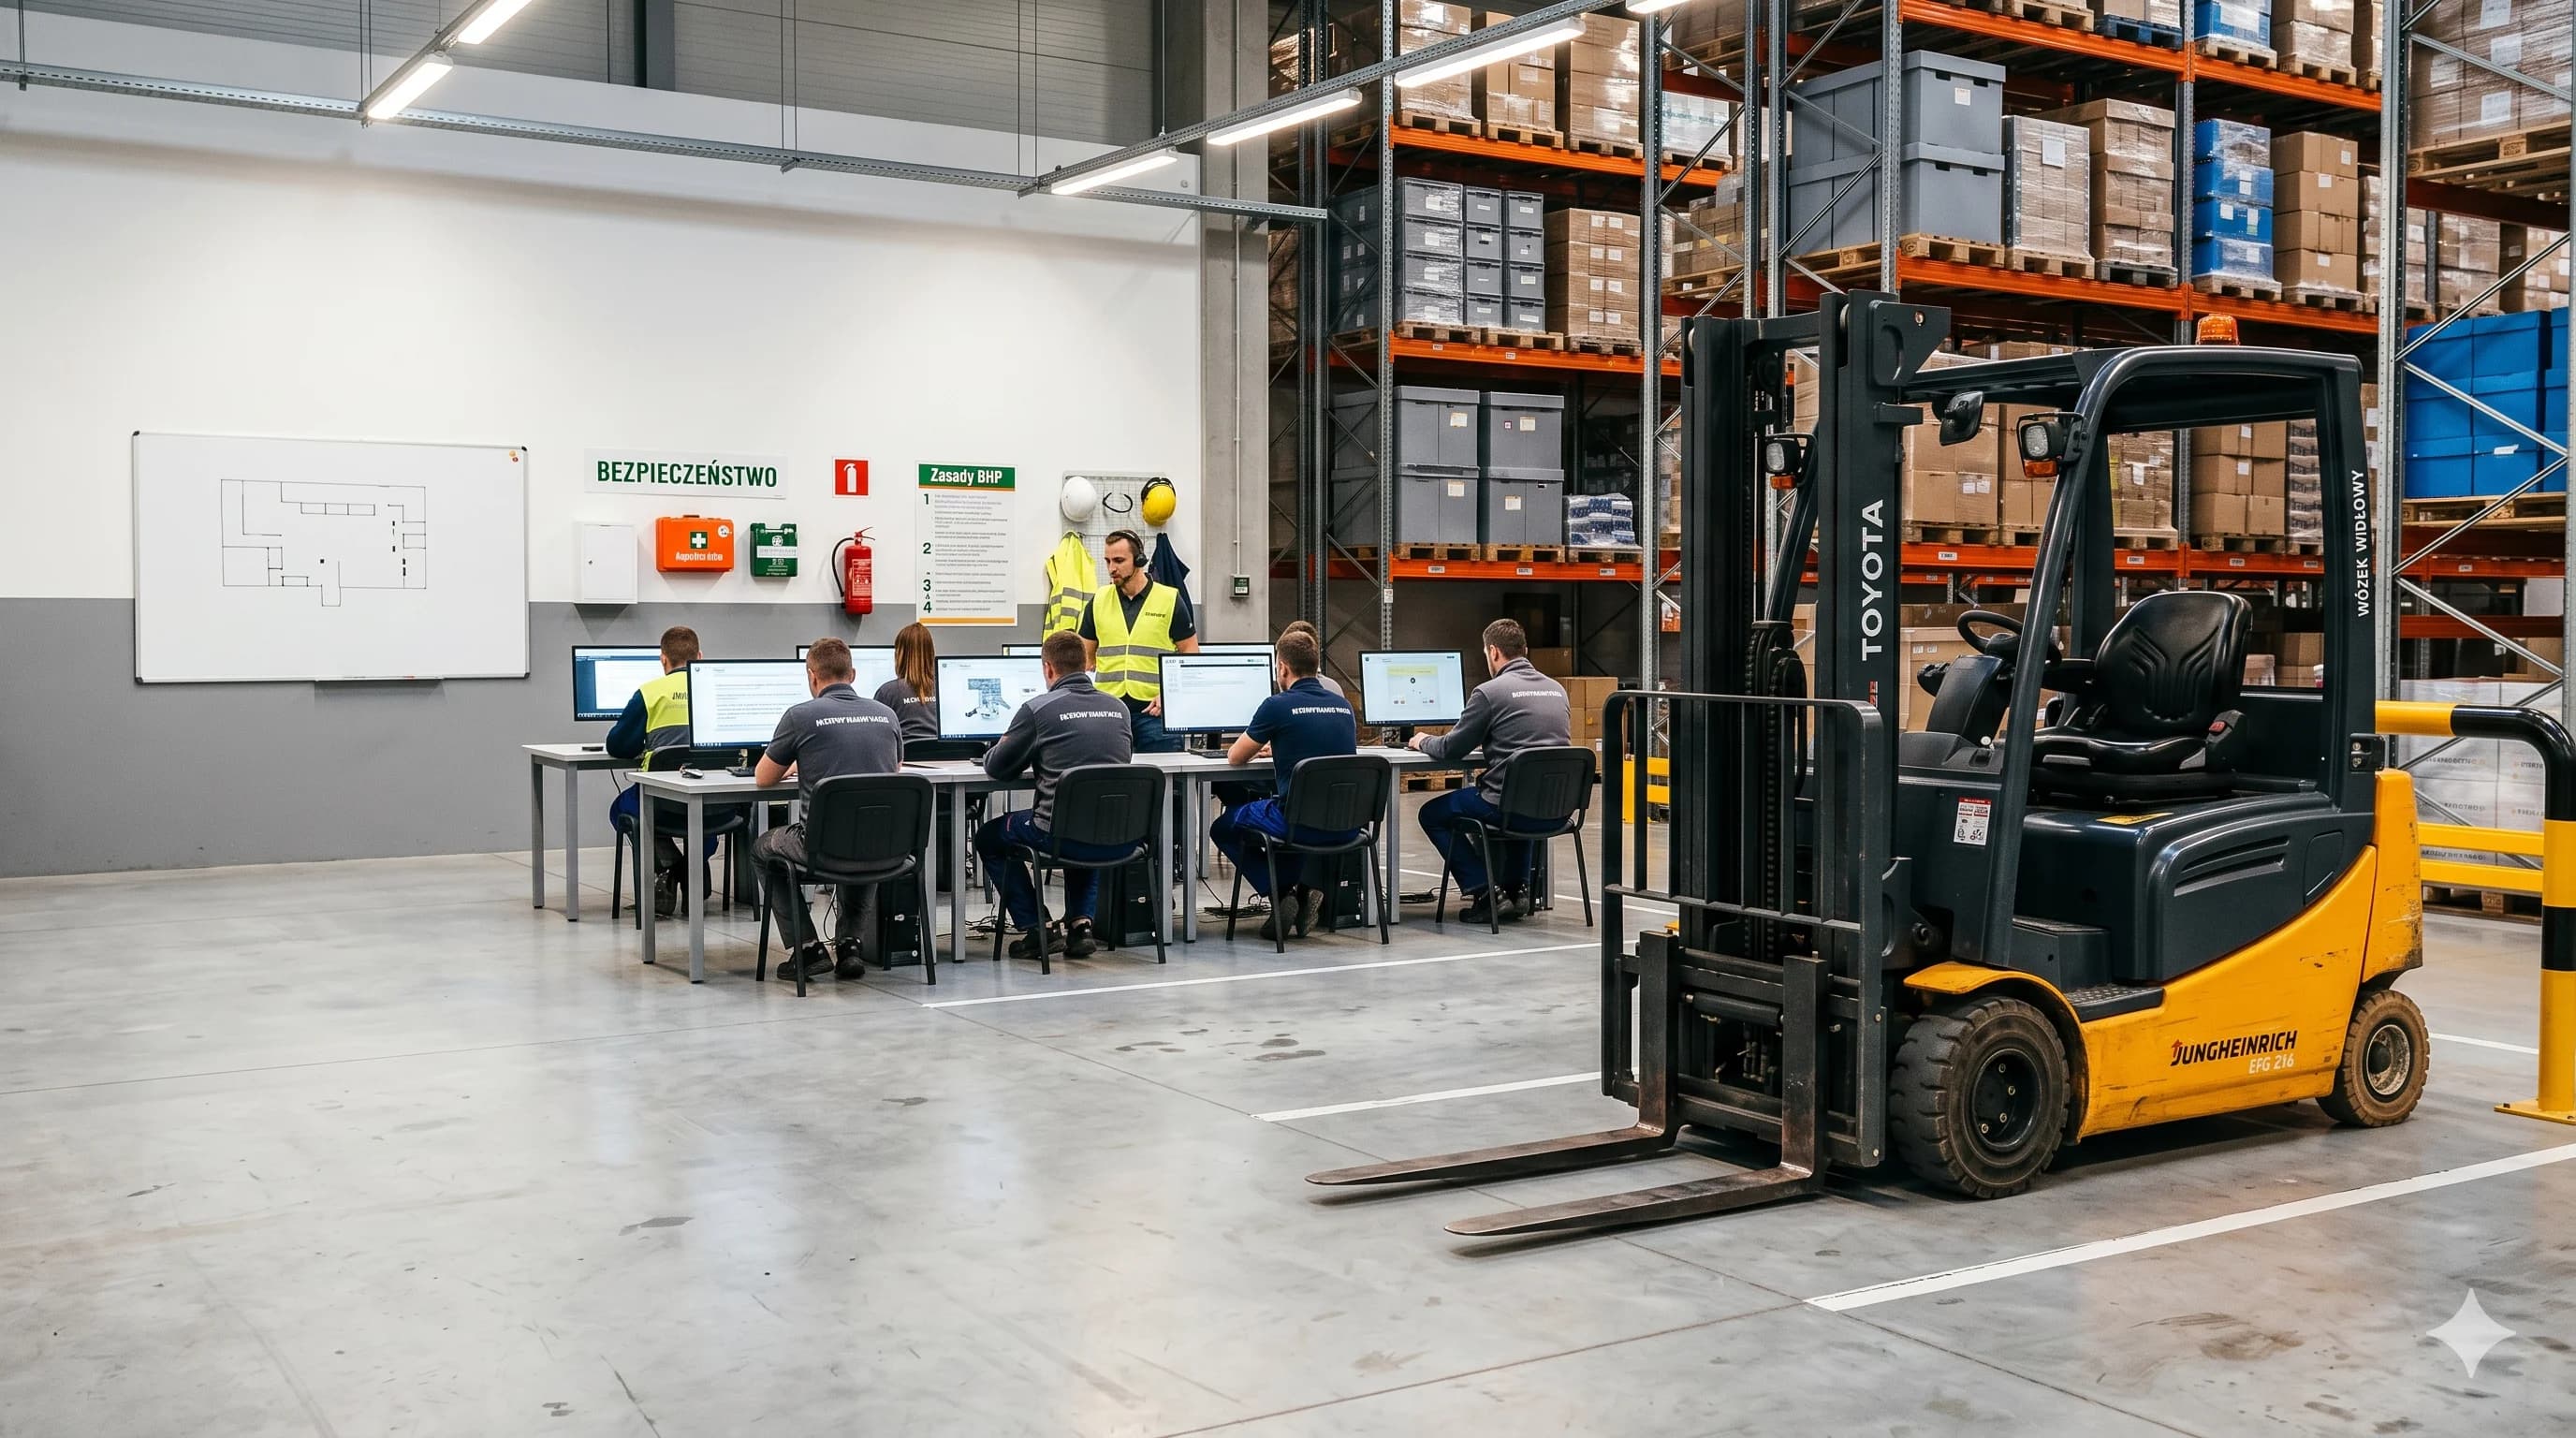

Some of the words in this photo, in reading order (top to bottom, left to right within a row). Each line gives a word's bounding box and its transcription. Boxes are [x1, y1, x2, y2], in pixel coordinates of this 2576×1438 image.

[596, 459, 777, 488] BEZPIECZEŃSTWO
[930, 467, 974, 487] Zasady
[977, 469, 1003, 484] BHP
[923, 493, 929, 506] 1
[2351, 470, 2367, 552] WIDŁOWY
[923, 542, 931, 554] 2
[923, 579, 931, 592] 3
[1862, 499, 1883, 662] TOYOTA
[2354, 557, 2370, 617] WÓZEK
[923, 601, 932, 613] 4
[2171, 1030, 2298, 1066] JUNGHEINRICH
[2248, 1056, 2271, 1074] EFG
[2273, 1053, 2294, 1069] 216
